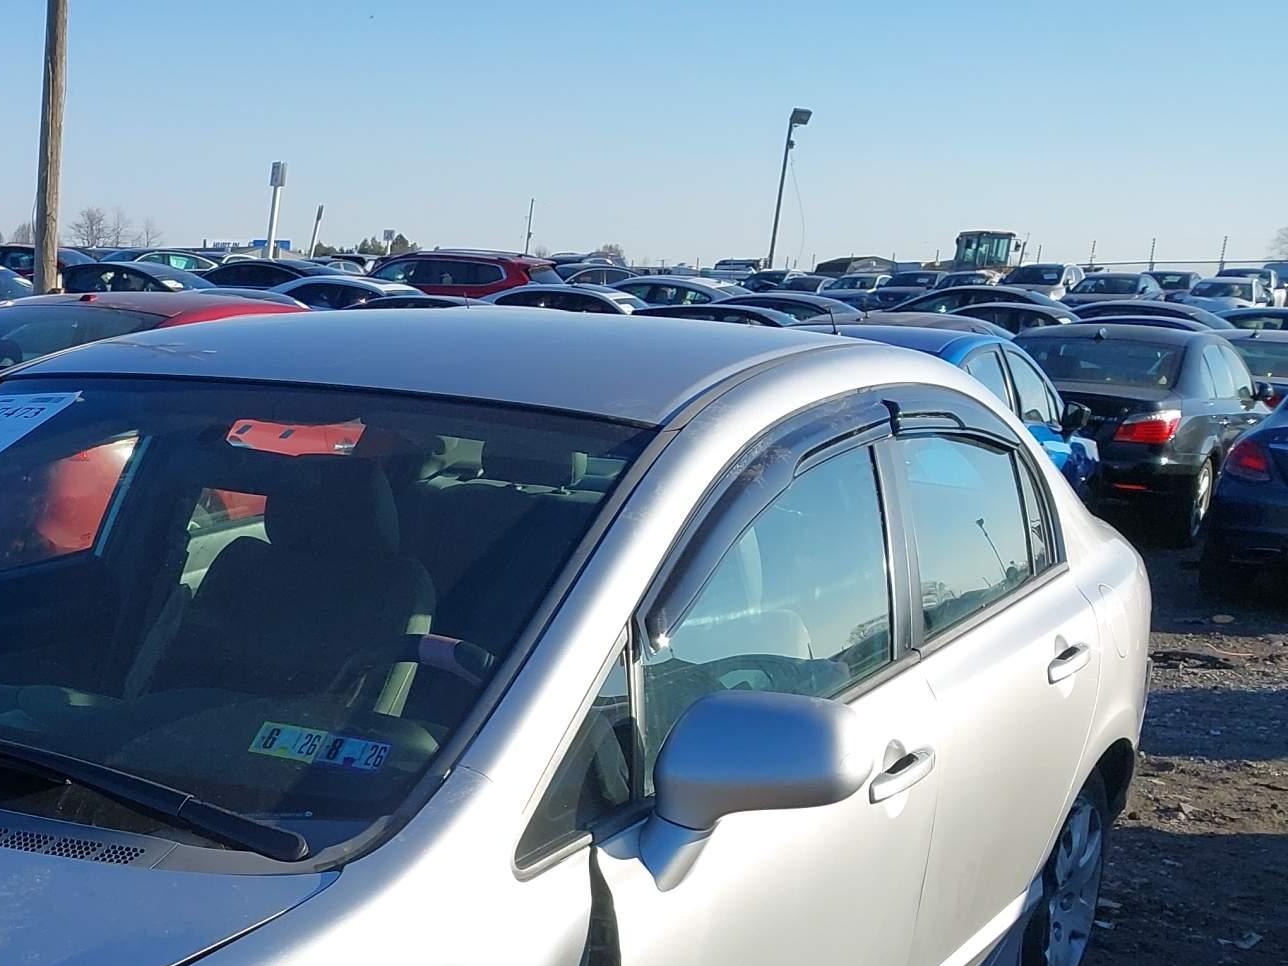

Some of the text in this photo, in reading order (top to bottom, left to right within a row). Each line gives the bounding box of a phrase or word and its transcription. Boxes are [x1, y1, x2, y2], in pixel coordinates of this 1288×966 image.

[262, 727, 322, 756] 6 26
[326, 738, 388, 768] 8 26
